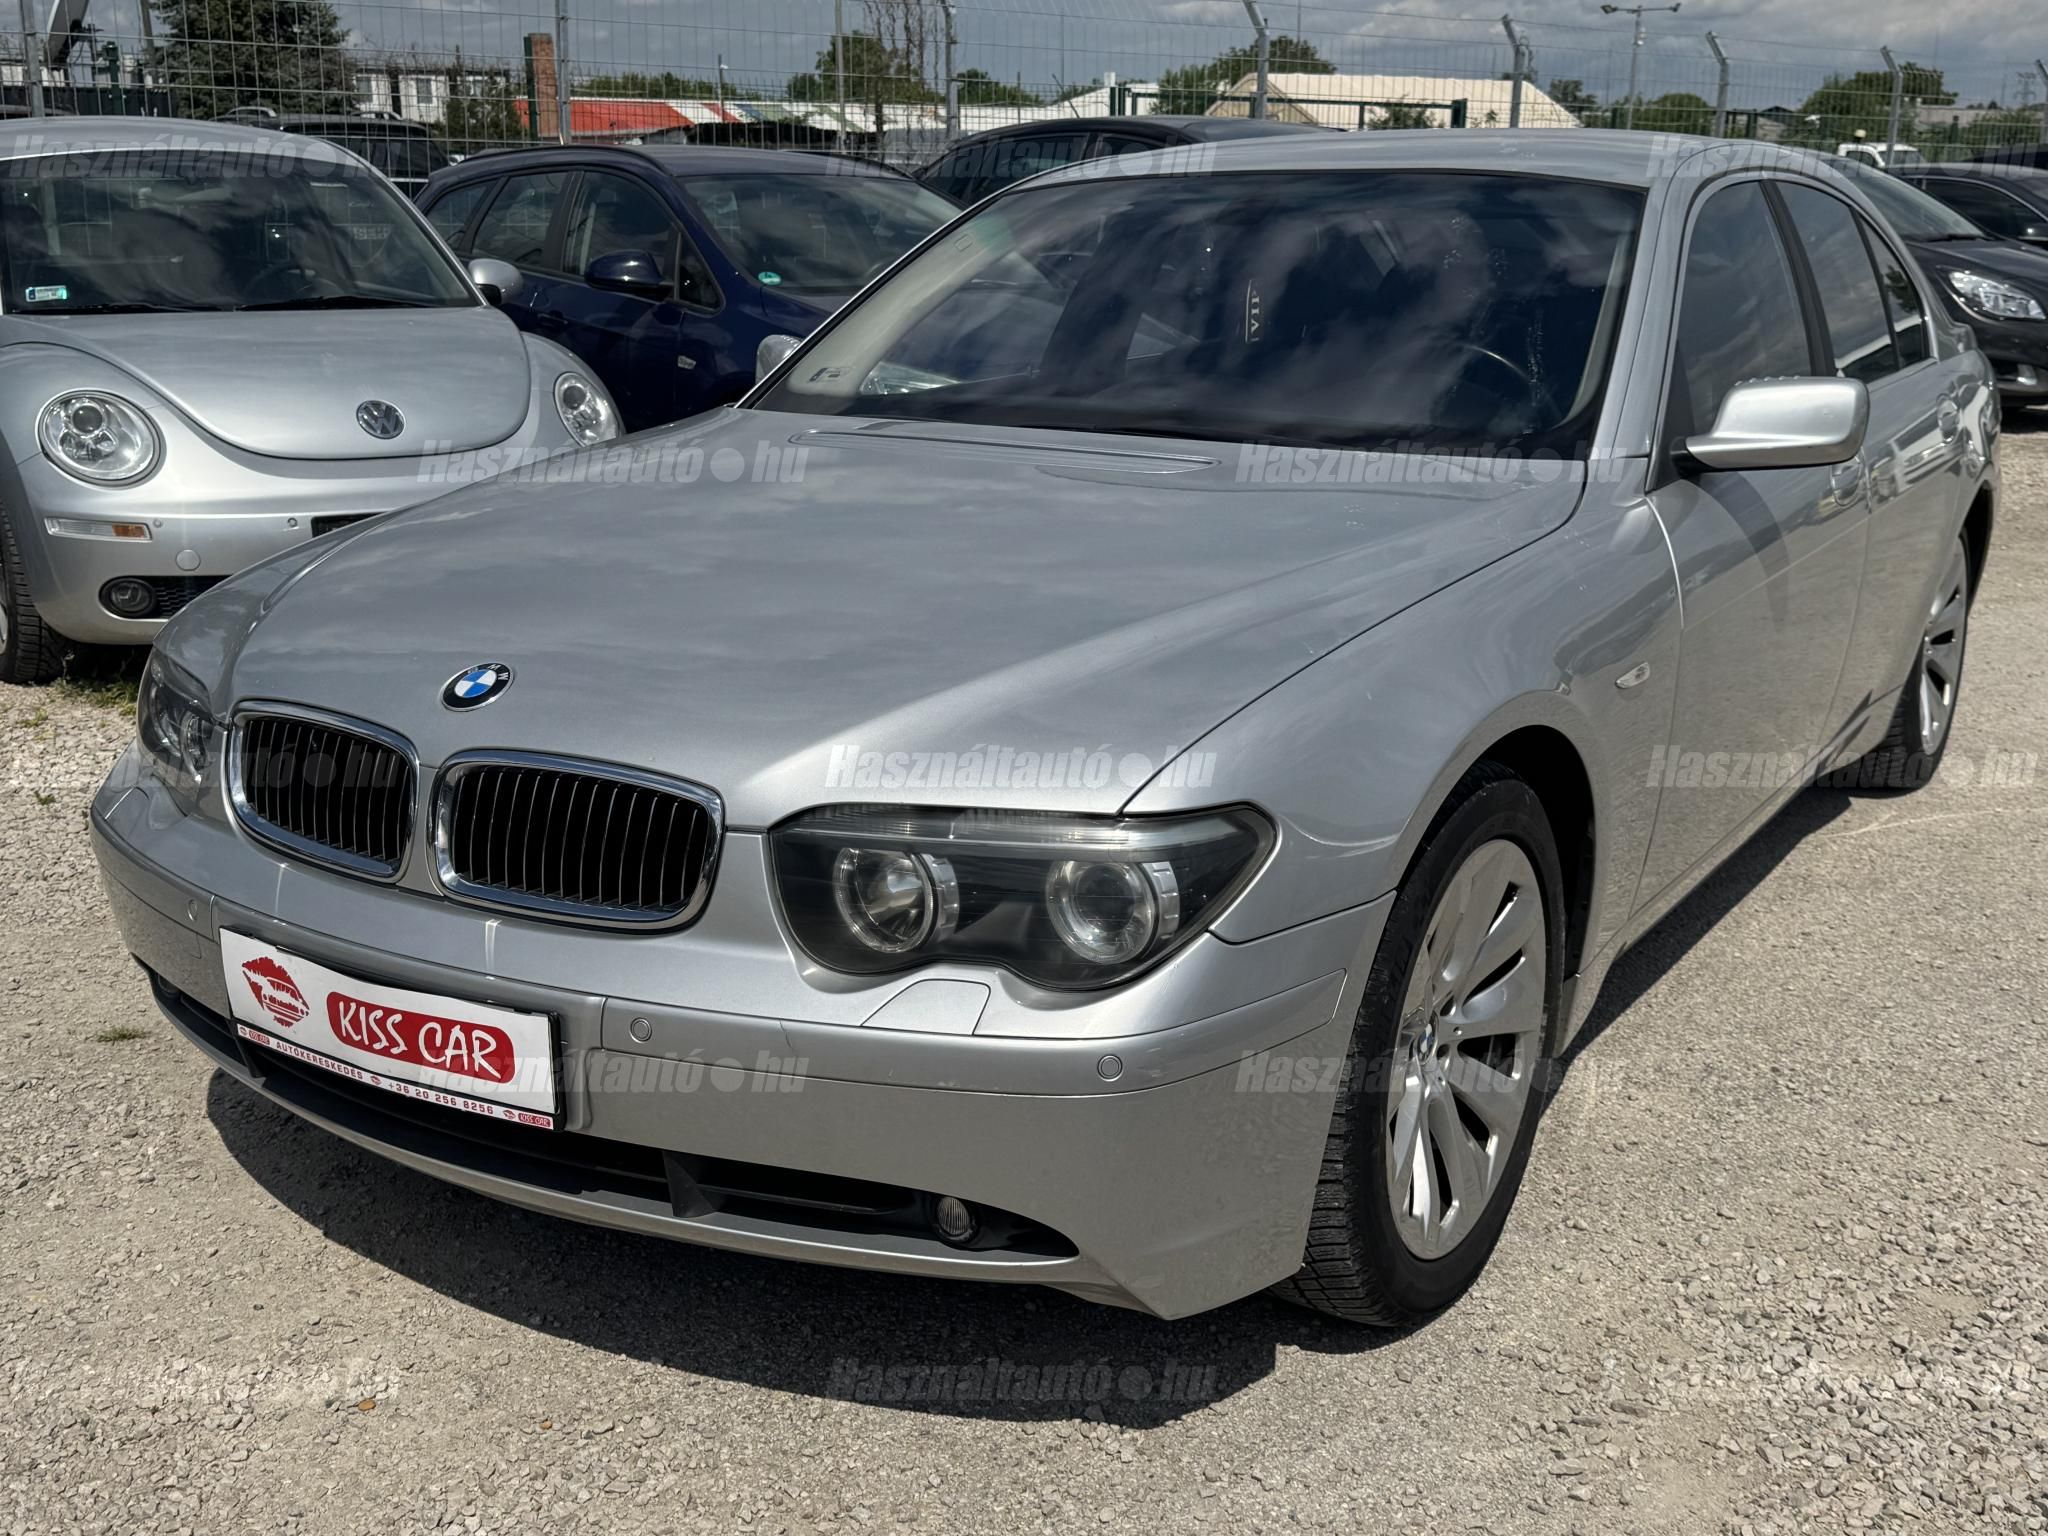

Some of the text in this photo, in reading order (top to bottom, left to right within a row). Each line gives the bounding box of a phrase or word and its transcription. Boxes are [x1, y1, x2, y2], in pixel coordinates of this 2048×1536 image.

[338, 1001, 502, 1079] KISS CAR
[389, 1082, 409, 1094] +36
[415, 1088, 429, 1099] 20
[435, 1093, 457, 1106] 256
[463, 1100, 494, 1115] 8256
